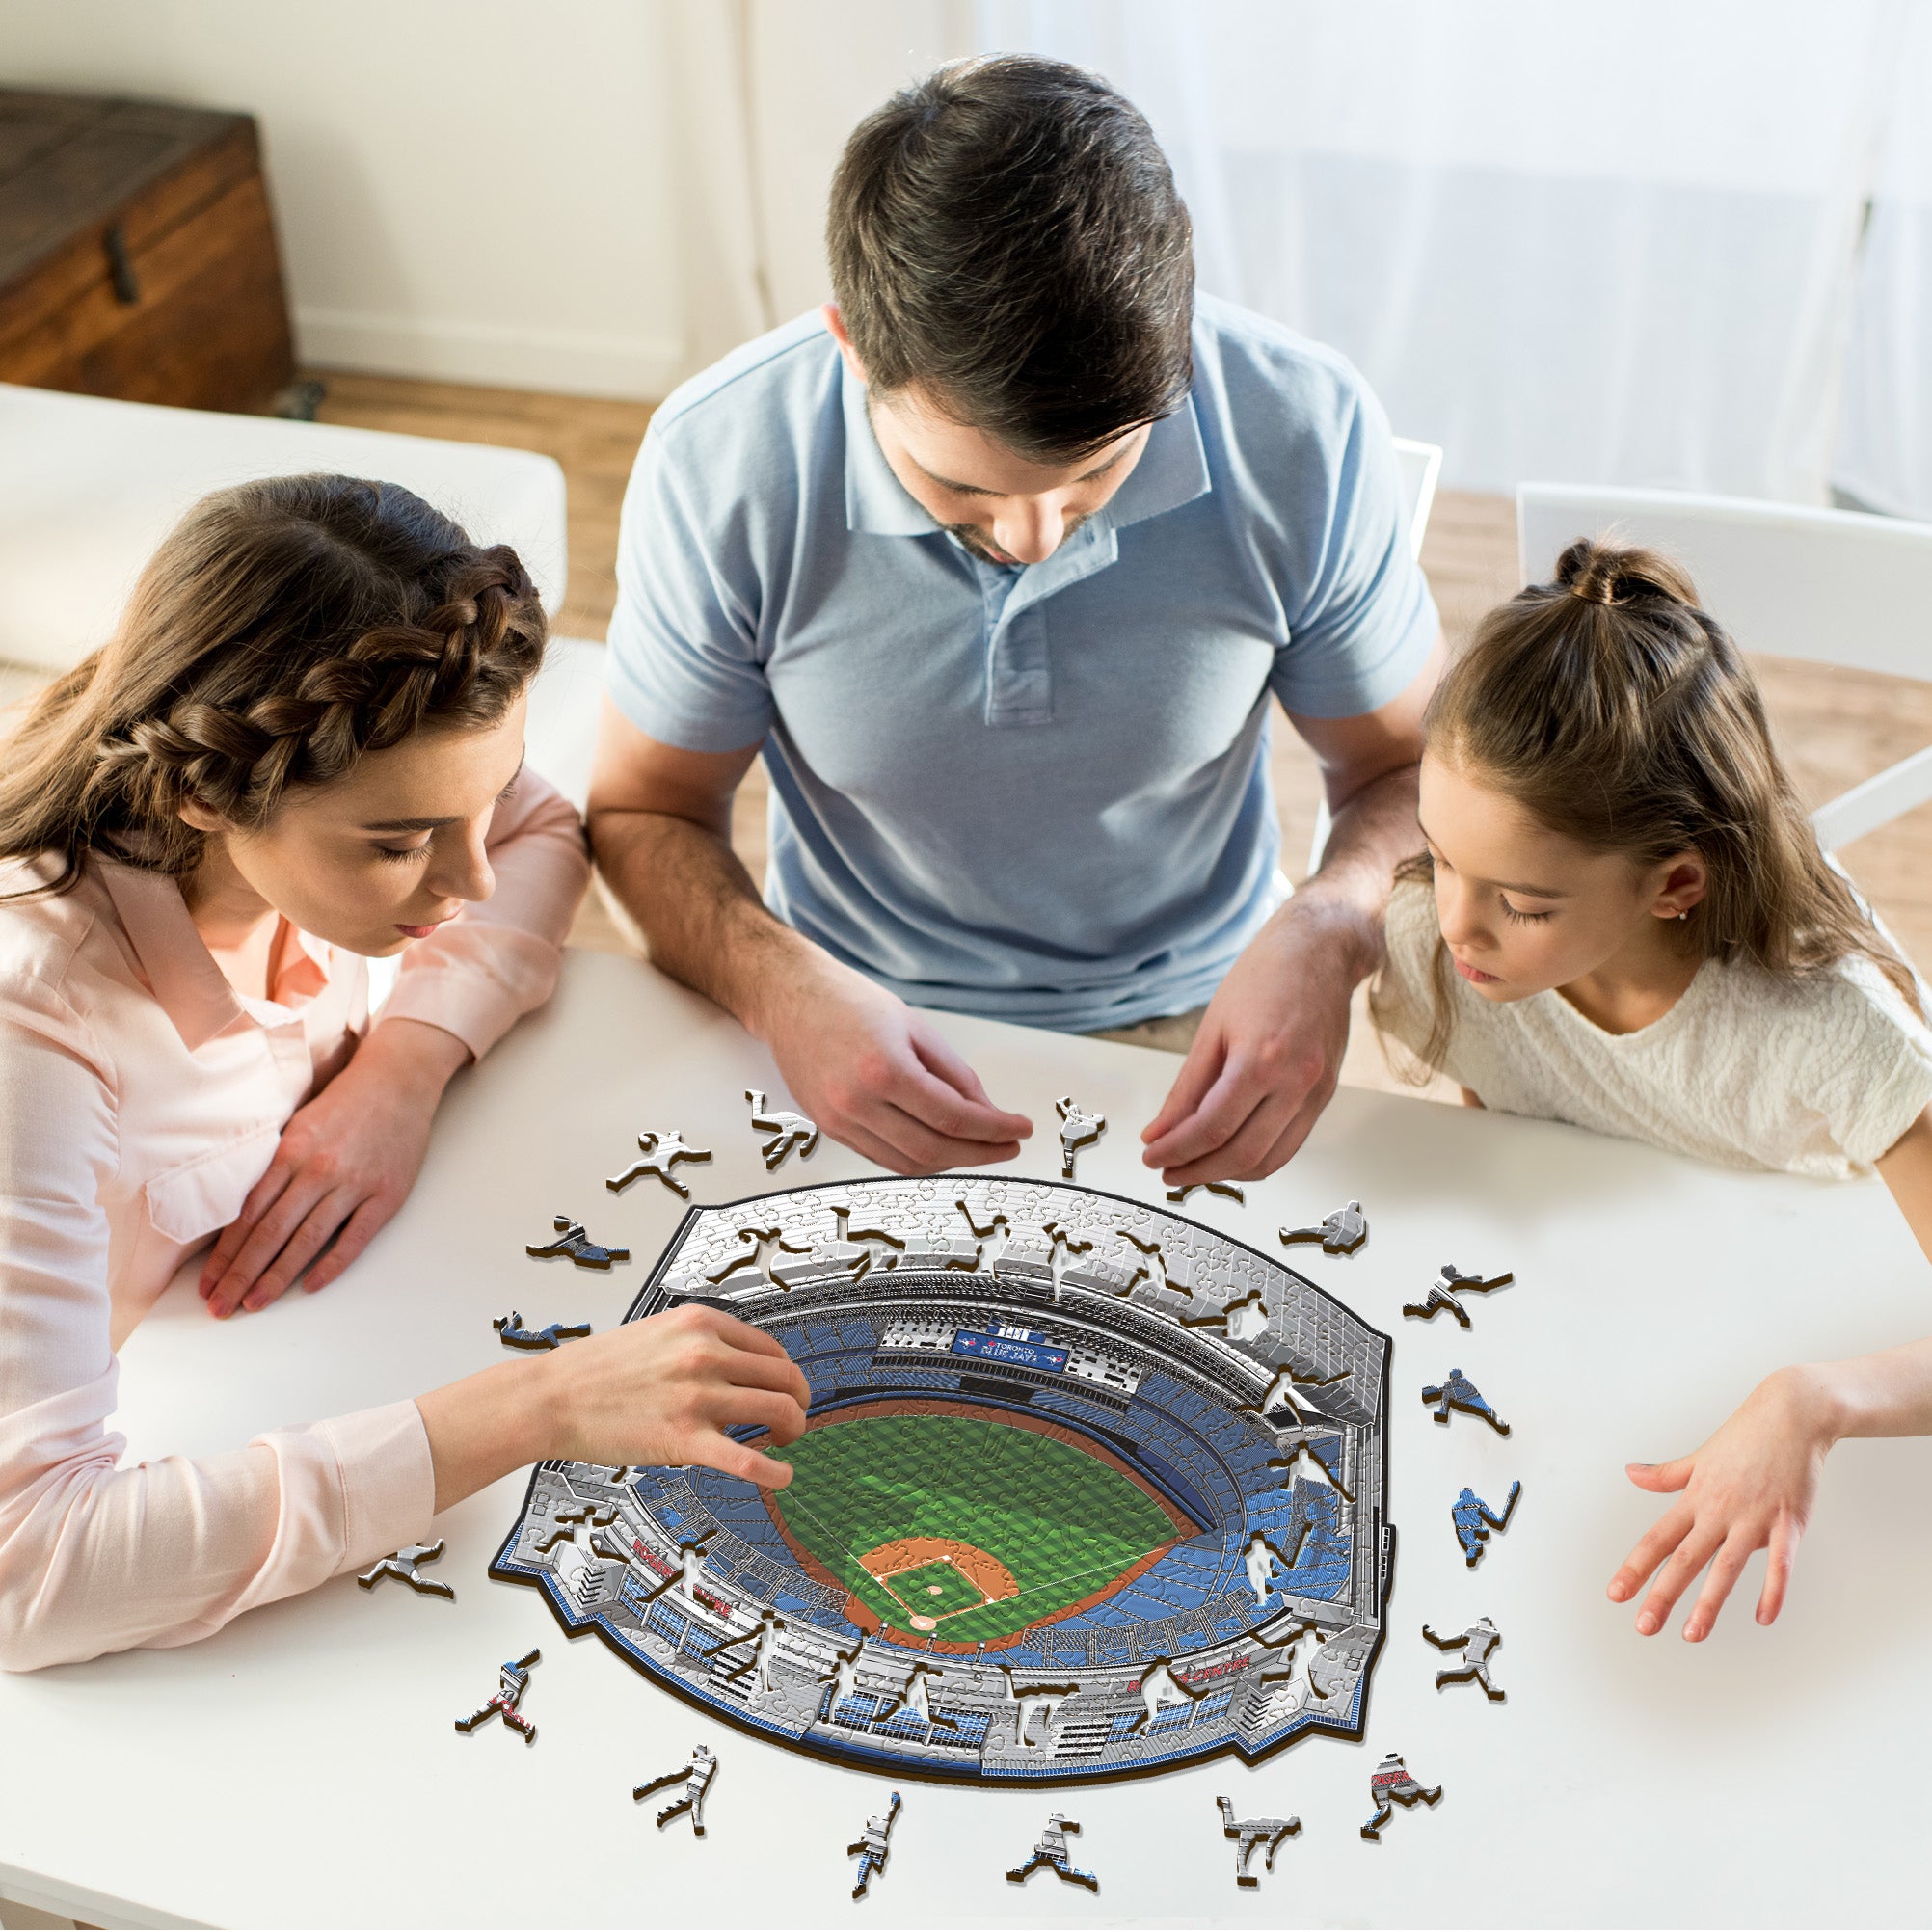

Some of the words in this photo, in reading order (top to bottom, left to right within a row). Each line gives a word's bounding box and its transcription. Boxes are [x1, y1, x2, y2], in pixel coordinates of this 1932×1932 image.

[980, 1345, 1009, 1358] BLUE
[1009, 1352, 1038, 1363] JAYS
[996, 1342, 1035, 1355] TORONTO
[632, 1539, 677, 1579] ROGER
[1193, 1655, 1251, 1683] CENTRE
